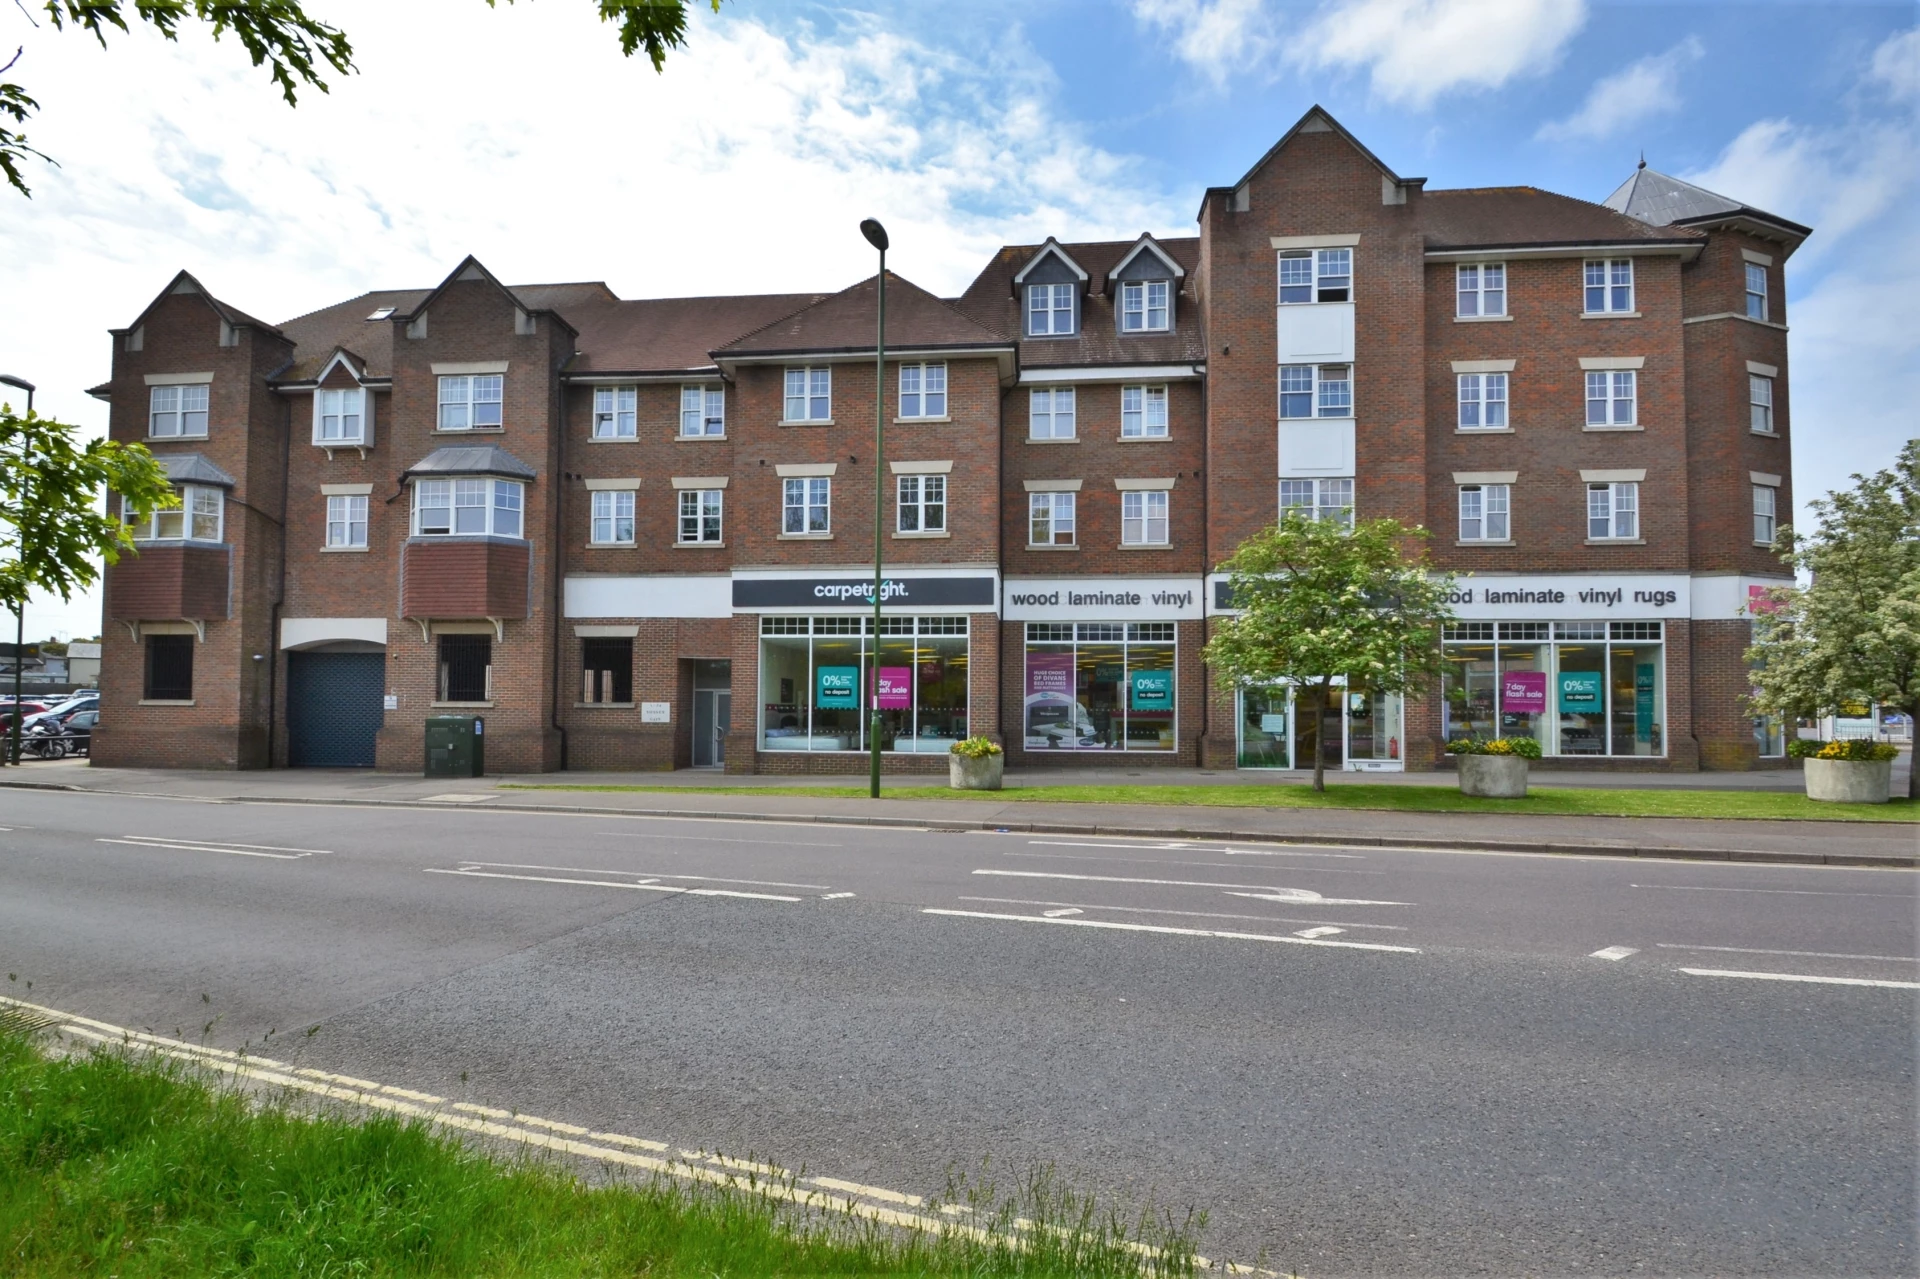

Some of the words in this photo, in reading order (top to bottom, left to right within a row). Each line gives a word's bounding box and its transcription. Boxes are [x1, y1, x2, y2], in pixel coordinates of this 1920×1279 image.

[1011, 591, 1059, 606] wood
[1068, 591, 1141, 606] laminate
[1151, 590, 1192, 608] vinyl
[1438, 588, 1473, 604] ood
[1485, 588, 1565, 604] laminate
[1578, 588, 1622, 607] vinyl
[1634, 589, 1677, 607] rugs
[823, 675, 841, 686] 0%
[1137, 678, 1155, 690] 0%
[1563, 680, 1583, 691] 0%
[891, 686, 908, 694] sale
[1511, 682, 1526, 692] day
[1505, 690, 1525, 698] flash
[1526, 690, 1543, 698] sale
[1574, 693, 1594, 701] deposit
